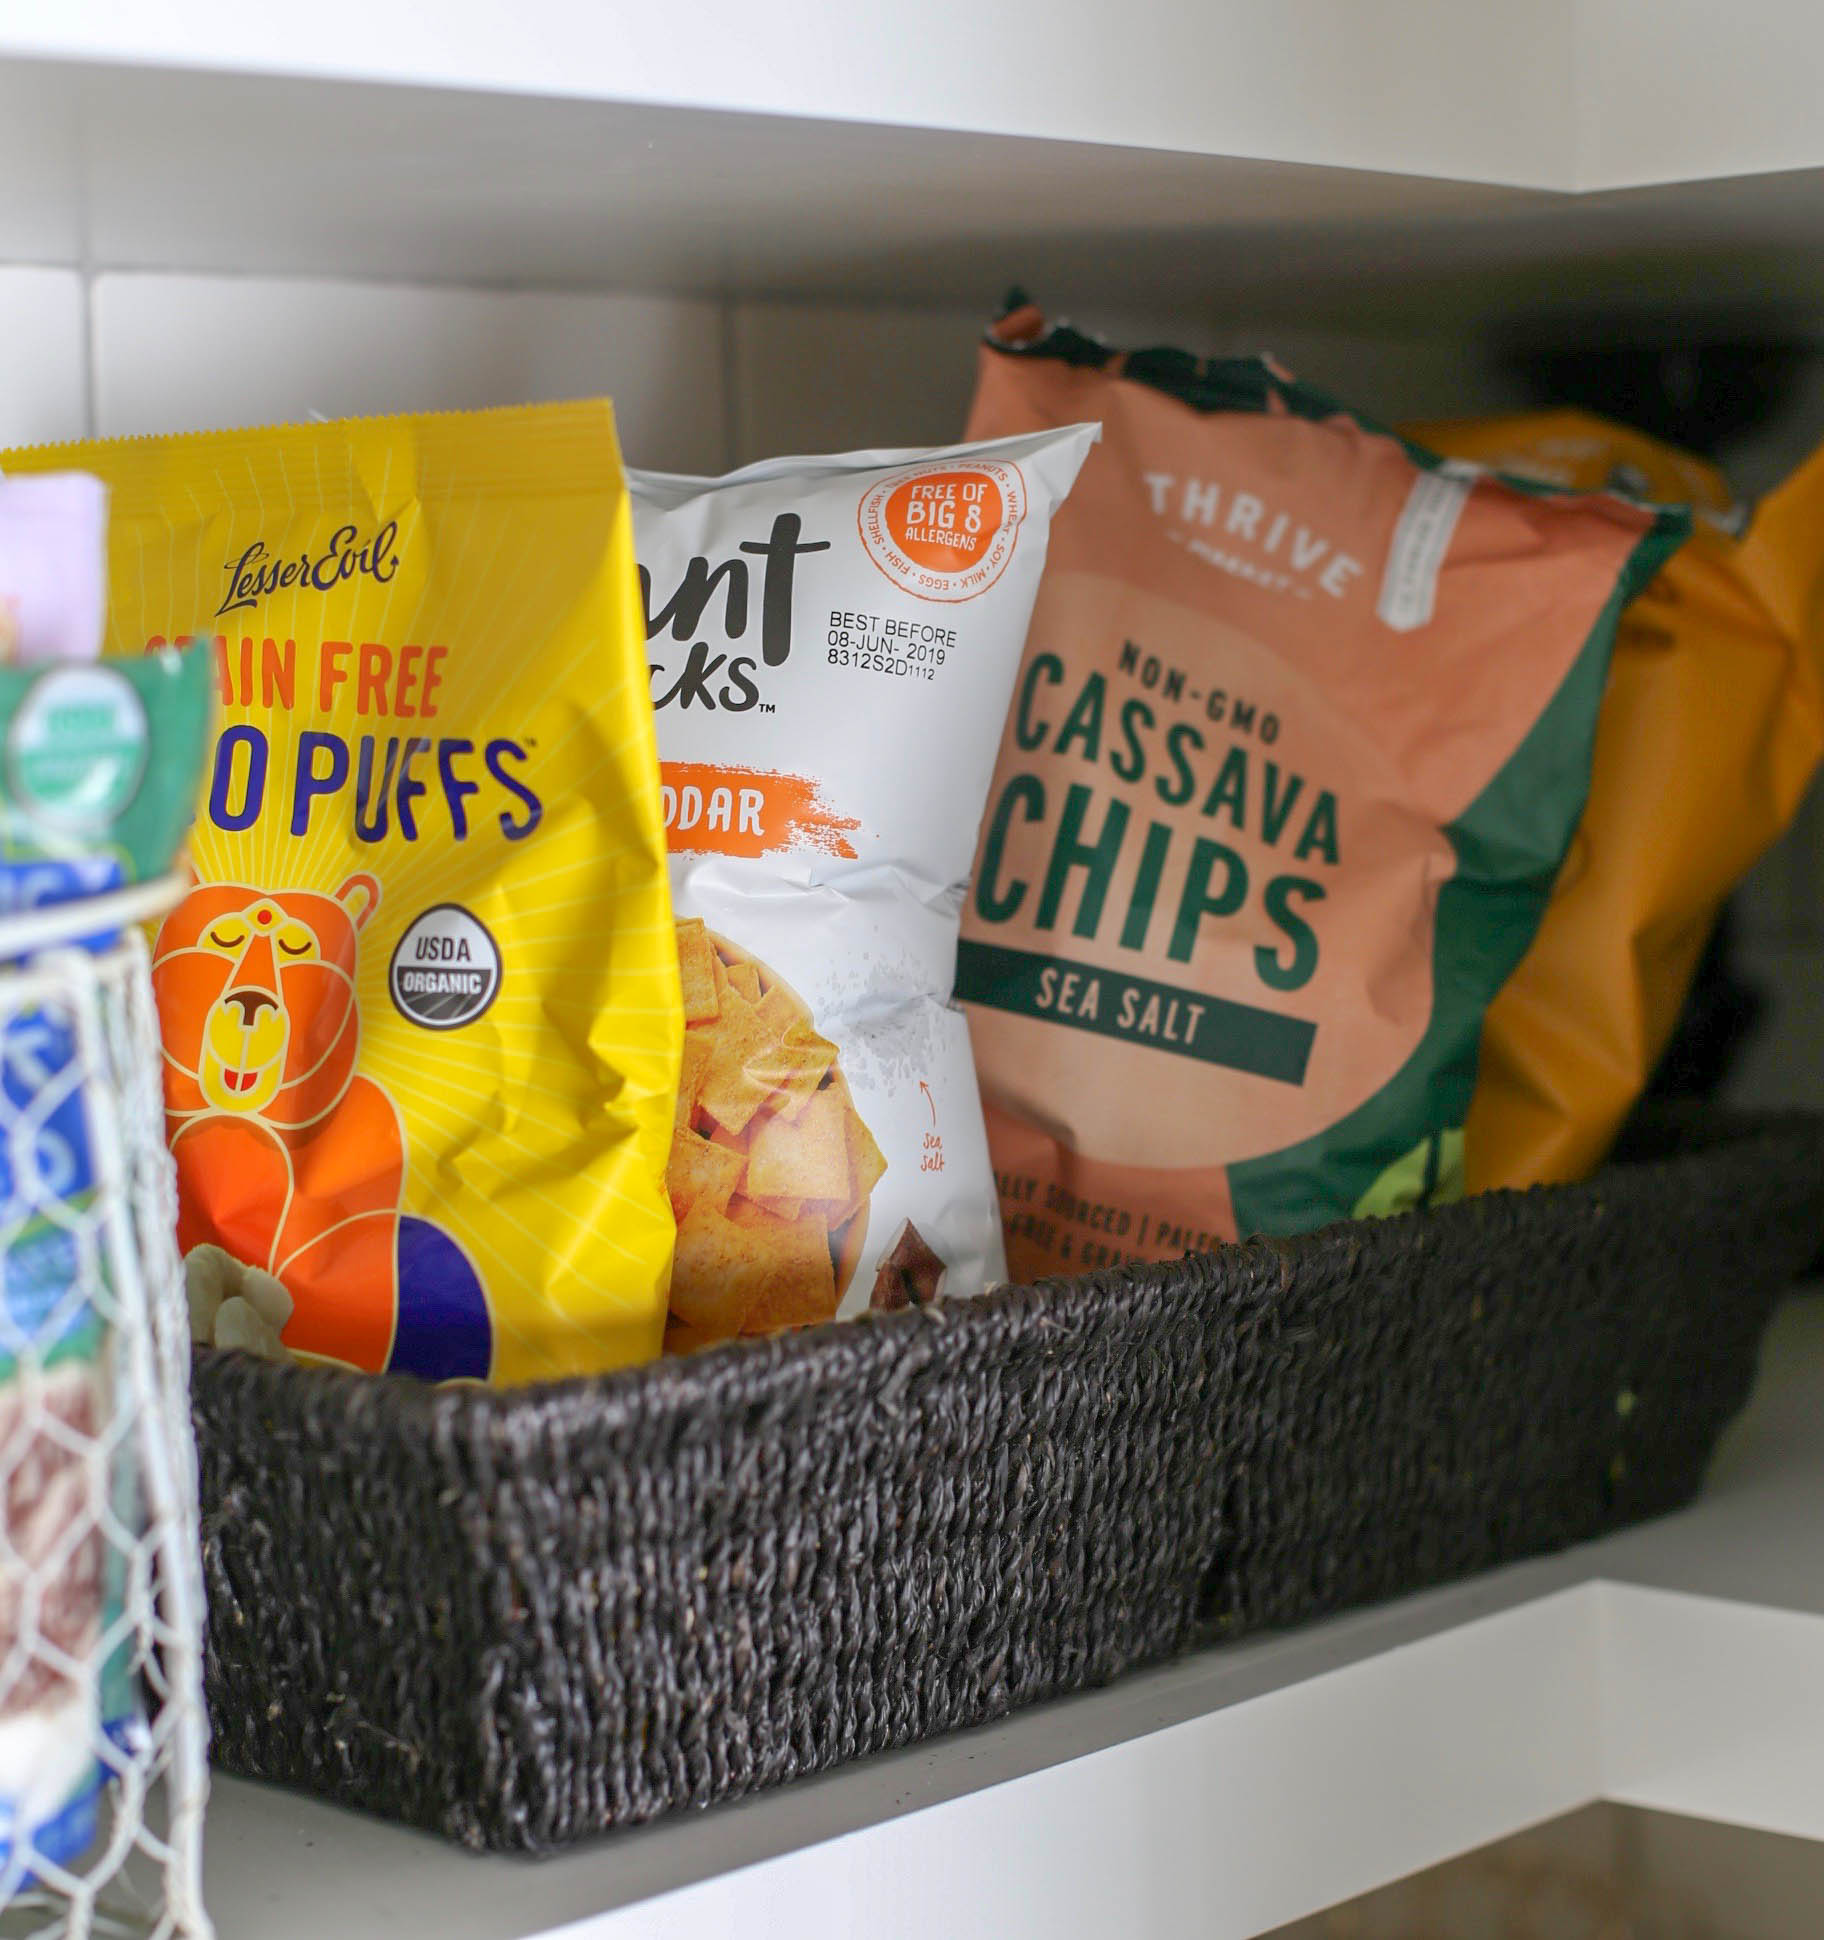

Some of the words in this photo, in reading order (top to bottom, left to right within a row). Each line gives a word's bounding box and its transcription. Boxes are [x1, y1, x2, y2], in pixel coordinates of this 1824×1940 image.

[911, 483, 958, 501] FREE
[963, 482, 988, 503] OF
[868, 494, 886, 546] SHELLFISH
[906, 500, 956, 529] BIG
[964, 504, 982, 533] 8
[1001, 490, 1018, 537] WHEAT
[905, 526, 977, 552] ALLERGENS
[1144, 472, 1364, 598] THRIVE
[884, 551, 912, 576] FISH
[988, 543, 1005, 569] SOY
[918, 573, 950, 590] EGGS
[960, 568, 987, 589] MILK
[830, 611, 880, 632] BEST
[884, 618, 957, 648] BEFORE
[907, 643, 946, 666] 2019
[144, 634, 297, 711] AIN
[319, 640, 449, 718] FREE
[1117, 638, 1281, 745] NON-GMO
[1015, 652, 1340, 865] CASSAVA
[207, 723, 270, 833] O
[290, 729, 544, 843] PUFFS
[974, 772, 1328, 992] CHIPS
[415, 936, 473, 962] USDA
[402, 971, 483, 995] ORGANIC
[1035, 967, 1100, 1020] SEA
[1116, 987, 1206, 1045] SALT
